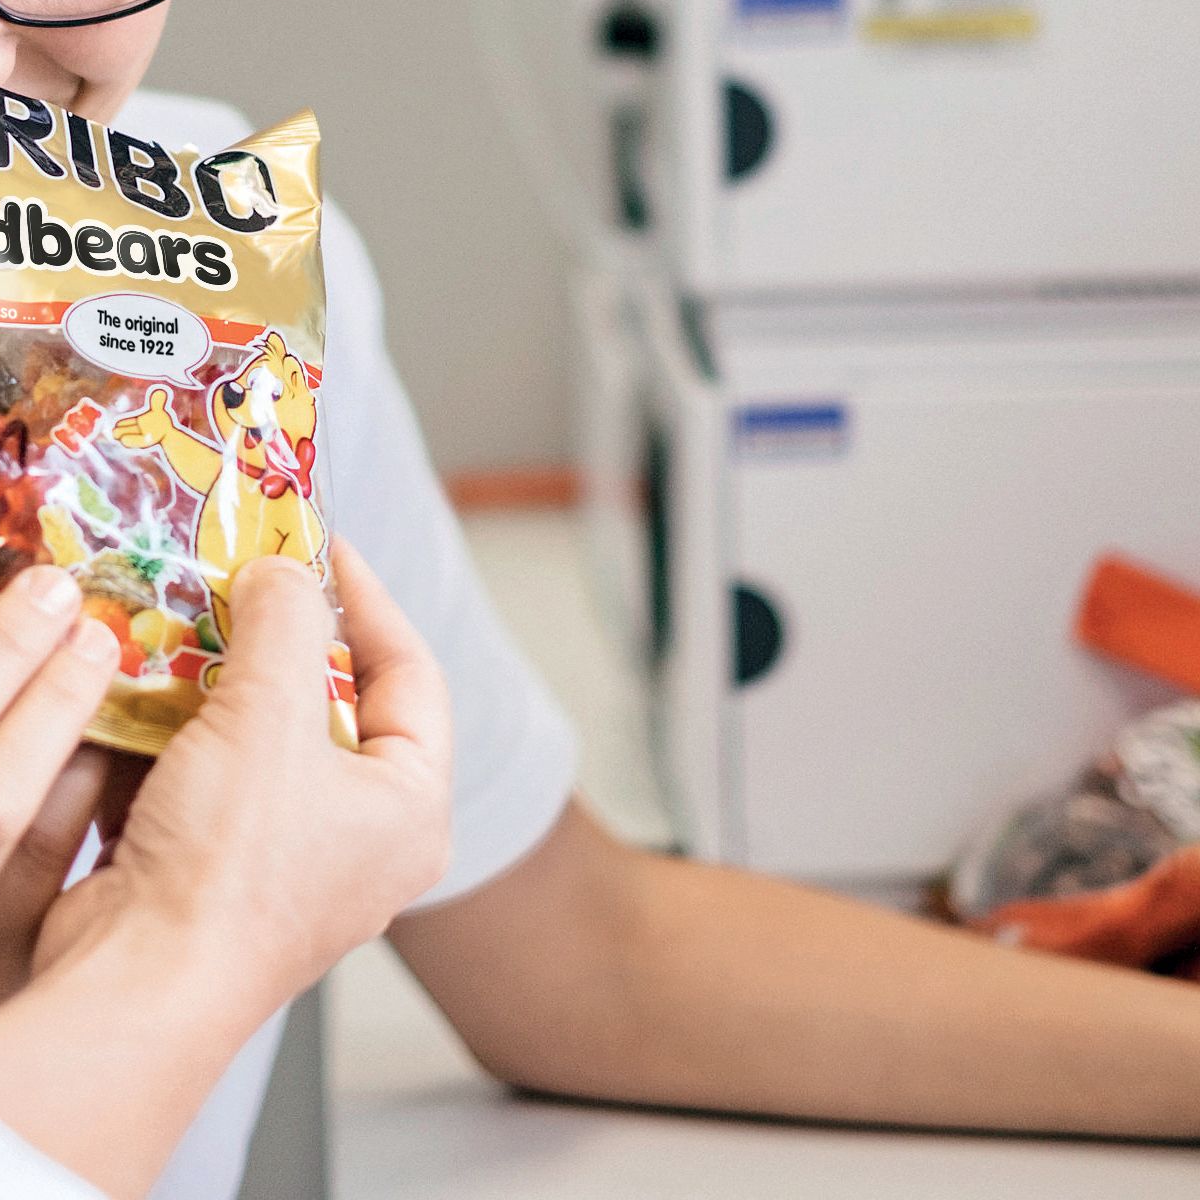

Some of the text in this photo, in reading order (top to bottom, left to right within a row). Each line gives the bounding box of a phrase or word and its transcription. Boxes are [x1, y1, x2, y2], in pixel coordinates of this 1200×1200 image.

[0, 307, 18, 320] so
[97, 309, 178, 336] The original
[99, 332, 175, 356] since 1922
